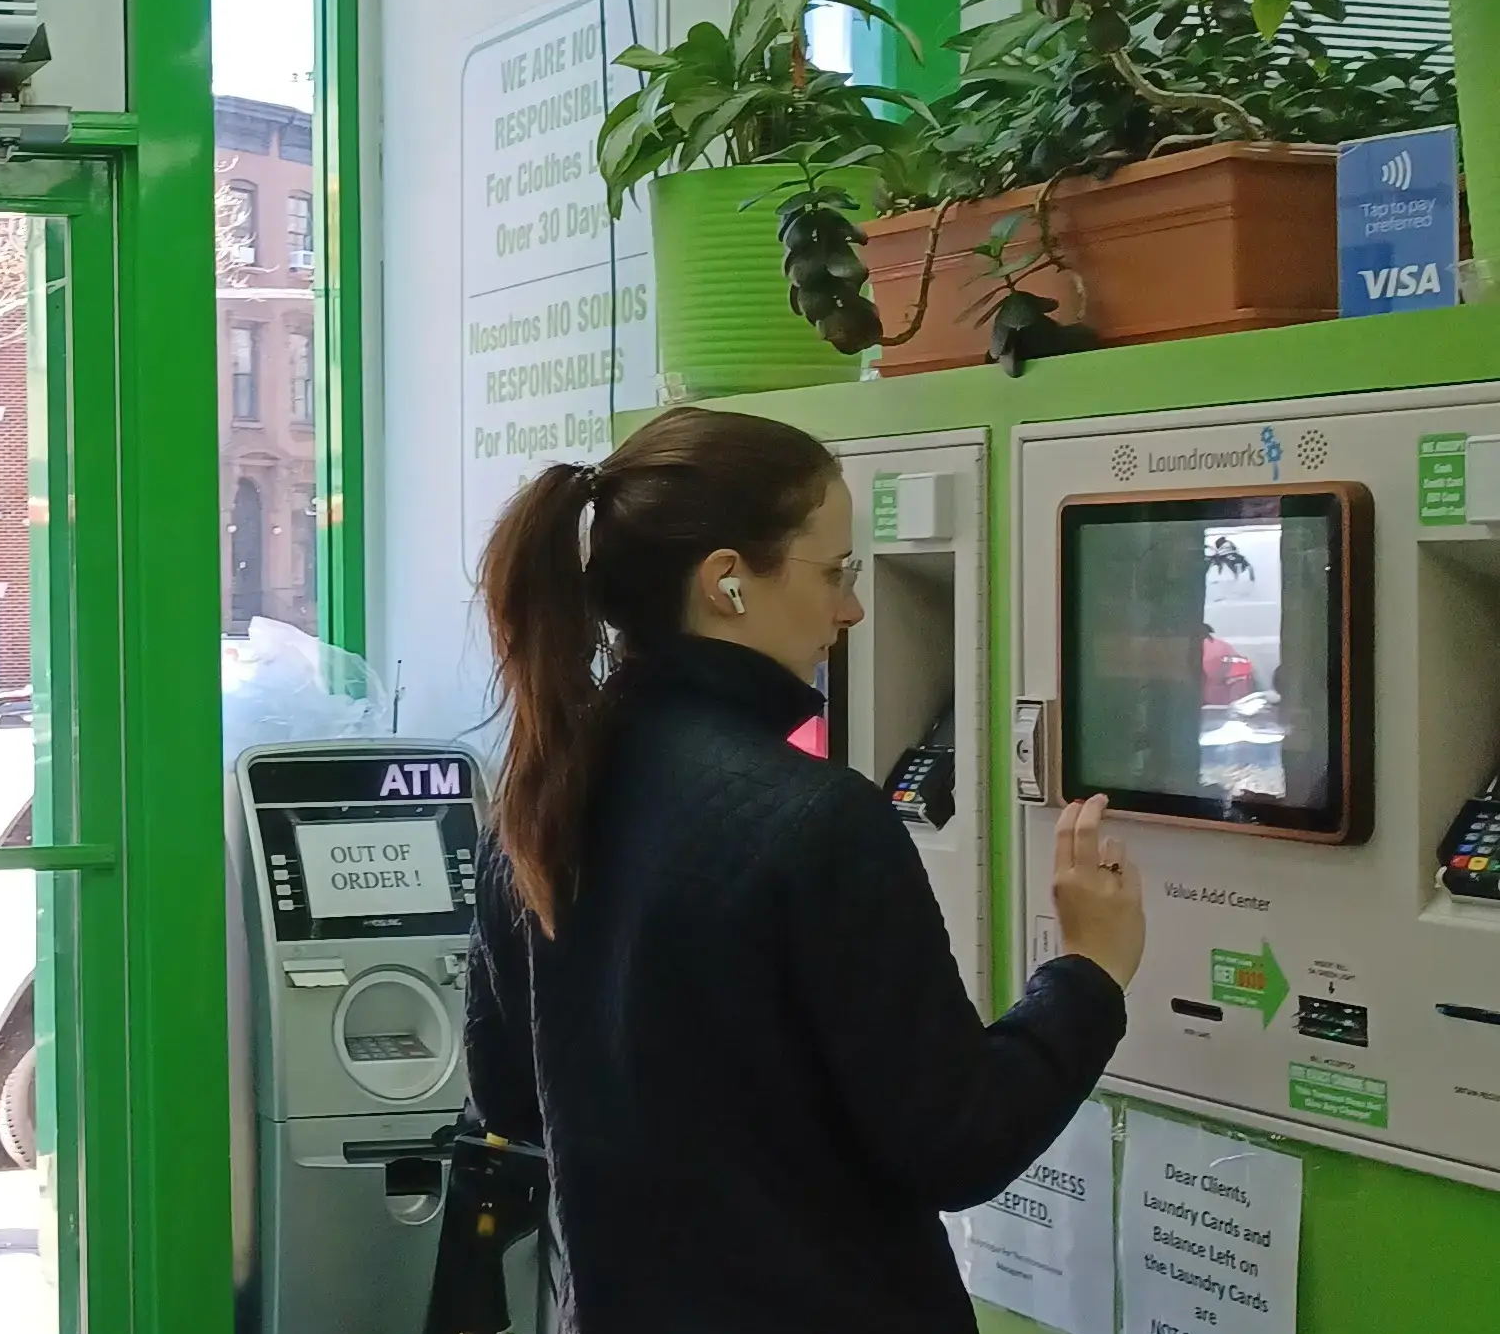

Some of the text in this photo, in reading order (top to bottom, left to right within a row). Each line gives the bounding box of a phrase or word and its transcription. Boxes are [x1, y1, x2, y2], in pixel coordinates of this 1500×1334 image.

[500, 53, 527, 93] WE
[532, 36, 566, 83] ARE
[495, 72, 614, 151] RESPONSIBLE
[486, 173, 512, 207] For
[516, 151, 582, 197] Clothes
[1360, 198, 1437, 219] Tap to pay
[1365, 214, 1433, 238] preferred
[496, 201, 610, 258] Over 30 Days
[1357, 263, 1441, 300] VISA
[469, 283, 647, 355] Nosotros NO SOMOS
[487, 348, 624, 404] RESPONSABLES
[475, 427, 501, 459] Por
[506, 421, 558, 460] Ropas
[1148, 443, 1266, 474] Laundroworks
[380, 763, 460, 796] ATM
[330, 844, 410, 864] OUT OF
[331, 870, 410, 890] ORDER
[1164, 880, 1271, 912] Value Add Center
[1164, 1163, 1251, 1208] Dear Clients,
[992, 1192, 1053, 1223] EPTED.
[1143, 1191, 1271, 1247] Laundry Cards and
[1153, 1225, 1258, 1277] Balance Left on
[1144, 1253, 1269, 1313] the Laundry Cards
[1194, 1306, 1217, 1325] are
